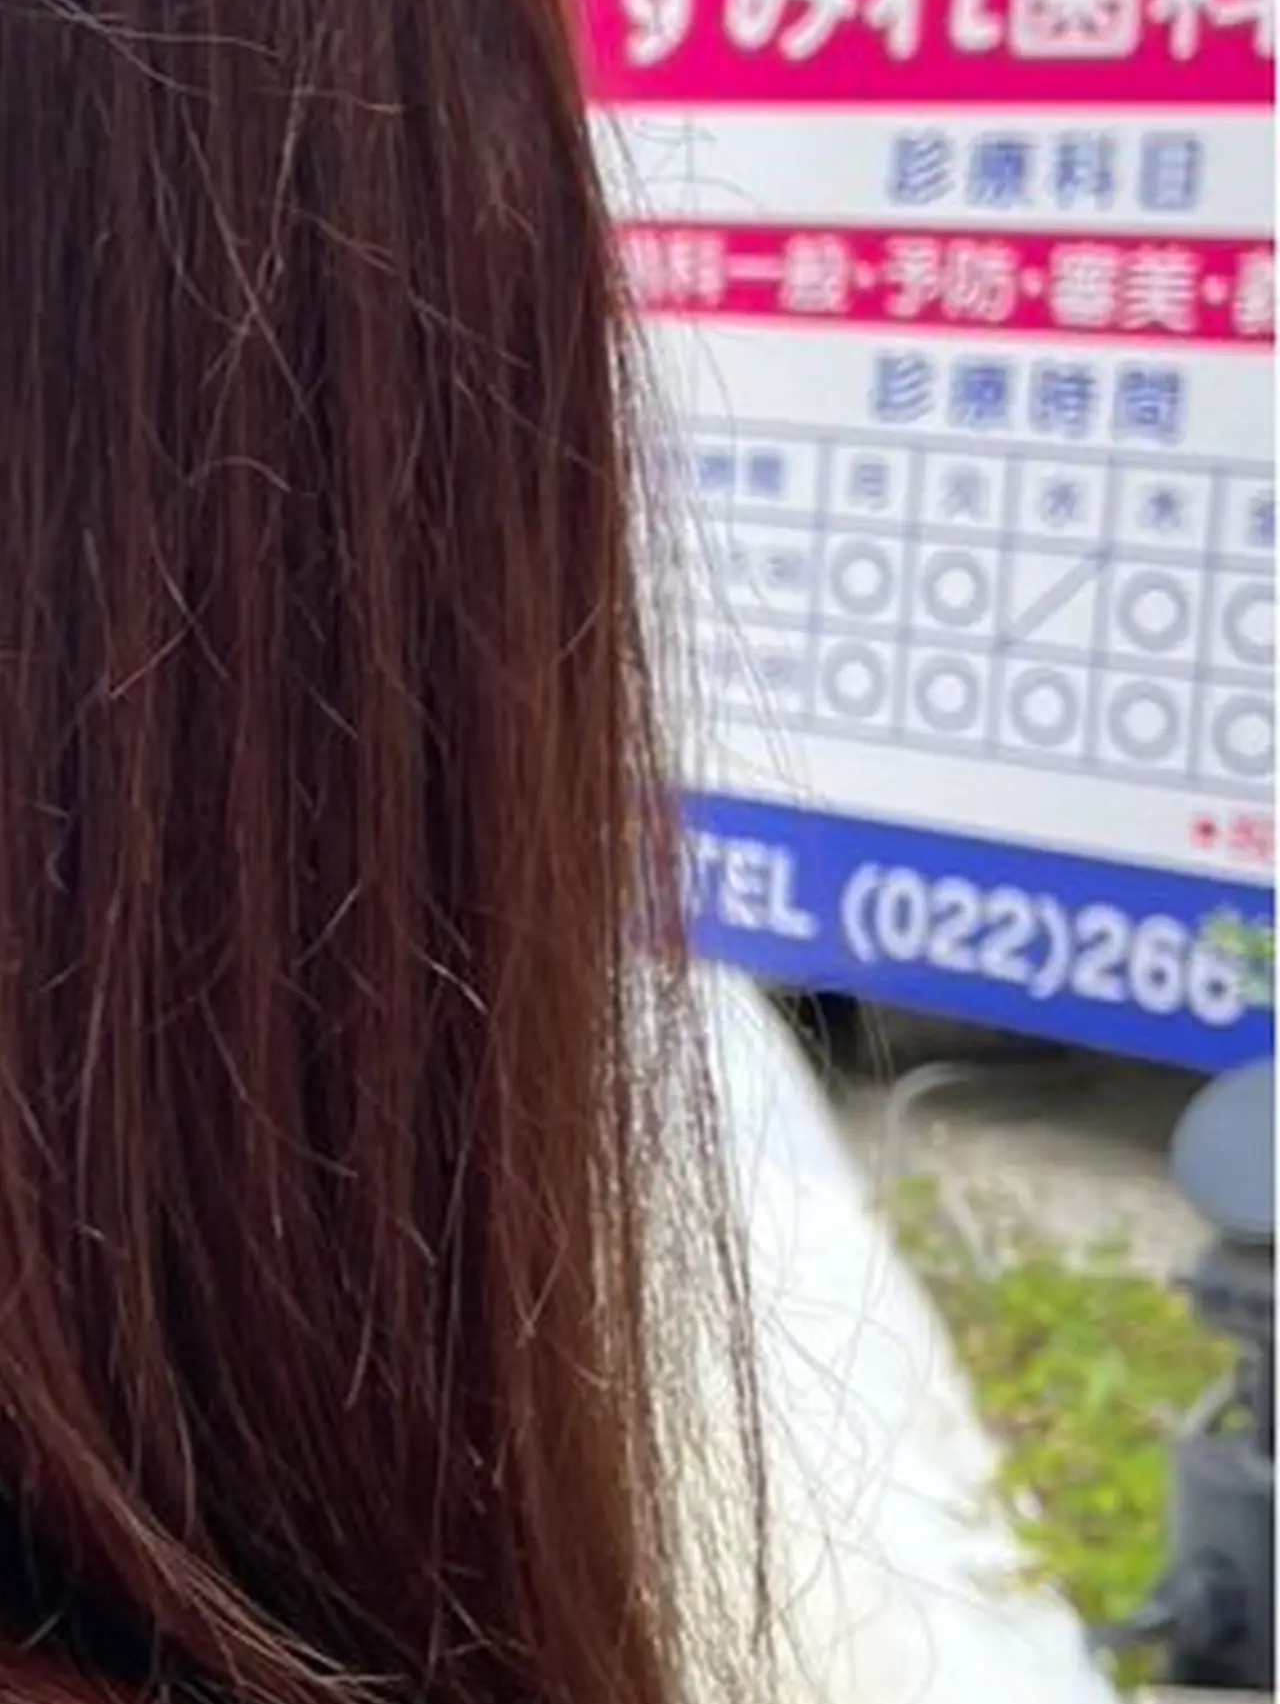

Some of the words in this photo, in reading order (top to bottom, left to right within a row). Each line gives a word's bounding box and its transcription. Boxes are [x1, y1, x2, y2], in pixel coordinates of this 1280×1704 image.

[887, 131, 1204, 212] 診療科目
[870, 350, 1186, 445] 診療時間
